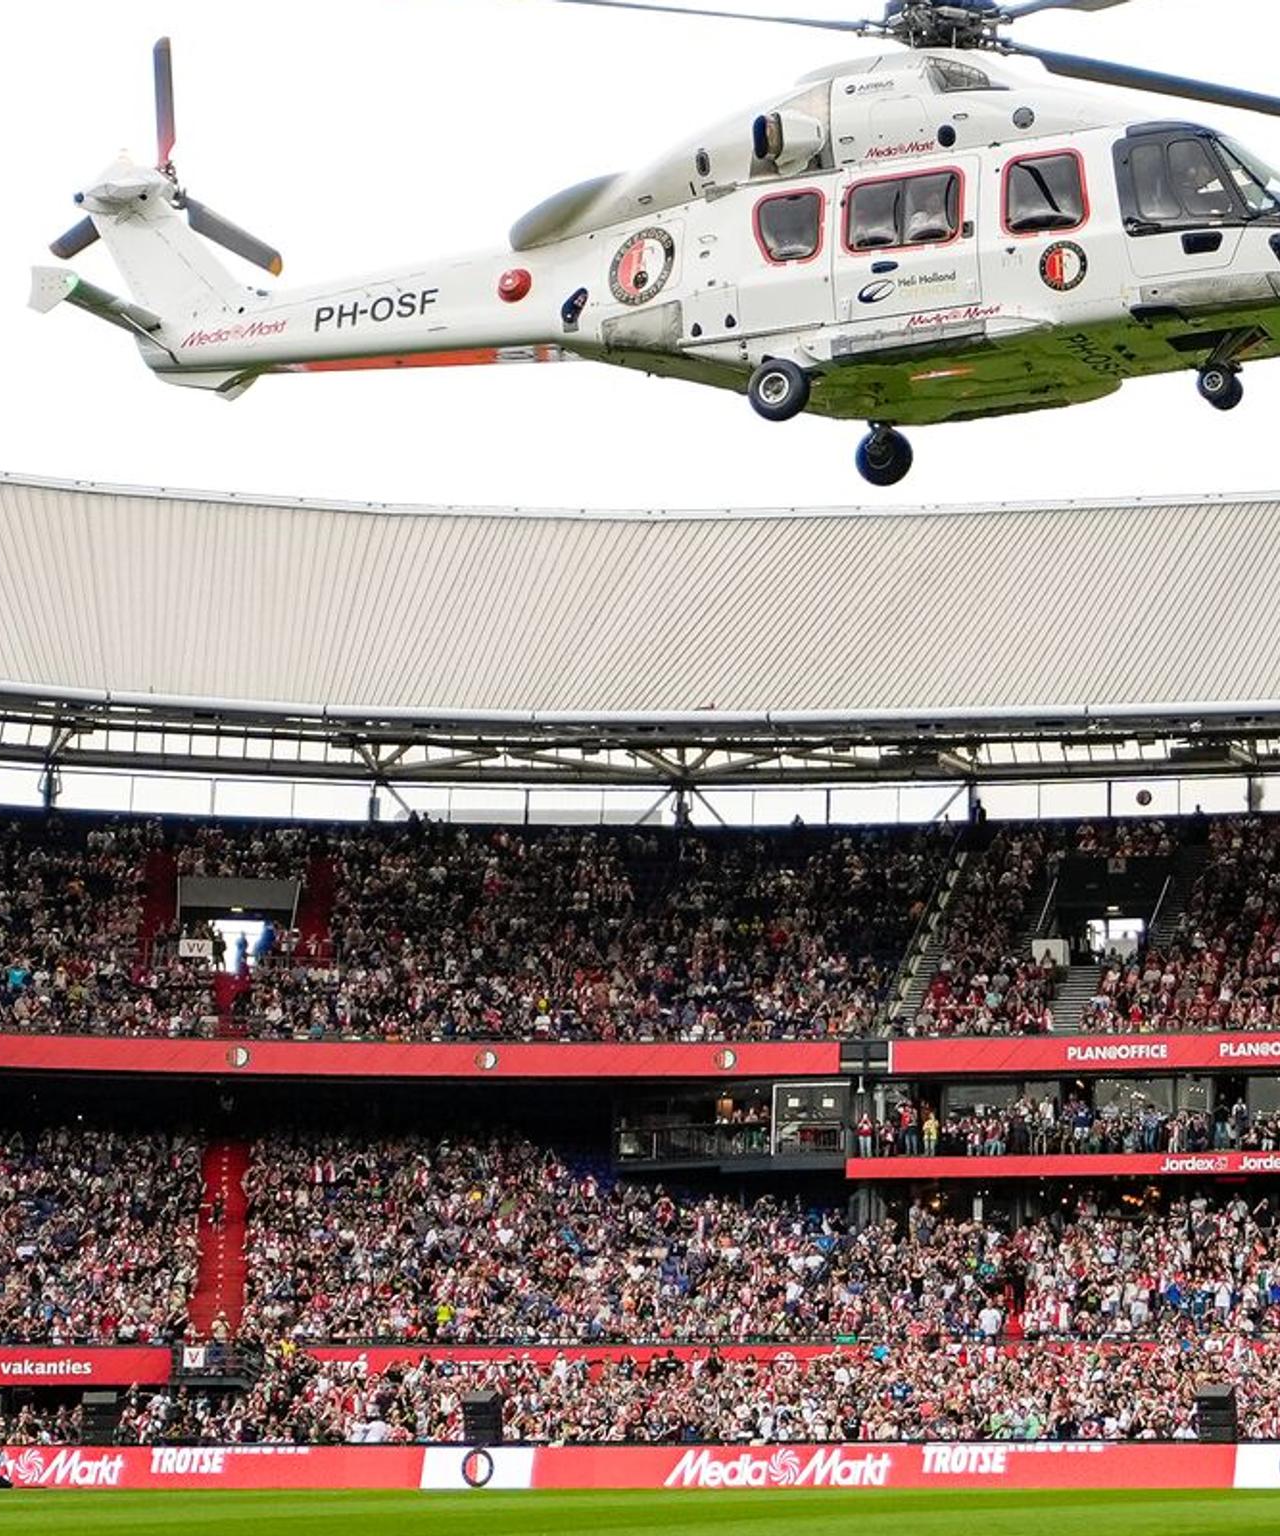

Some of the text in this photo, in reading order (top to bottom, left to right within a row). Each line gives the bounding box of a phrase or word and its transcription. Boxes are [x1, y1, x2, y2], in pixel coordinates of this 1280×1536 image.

[897, 271, 956, 287] Heli Holland
[314, 288, 439, 332] PH-OSF
[1160, 1156, 1215, 1172] Jordex
[188, 1351, 200, 1363] V
[0, 1359, 93, 1375] vakanties
[150, 1448, 225, 1473] TROTSE
[922, 1446, 1006, 1473] TROTSE
